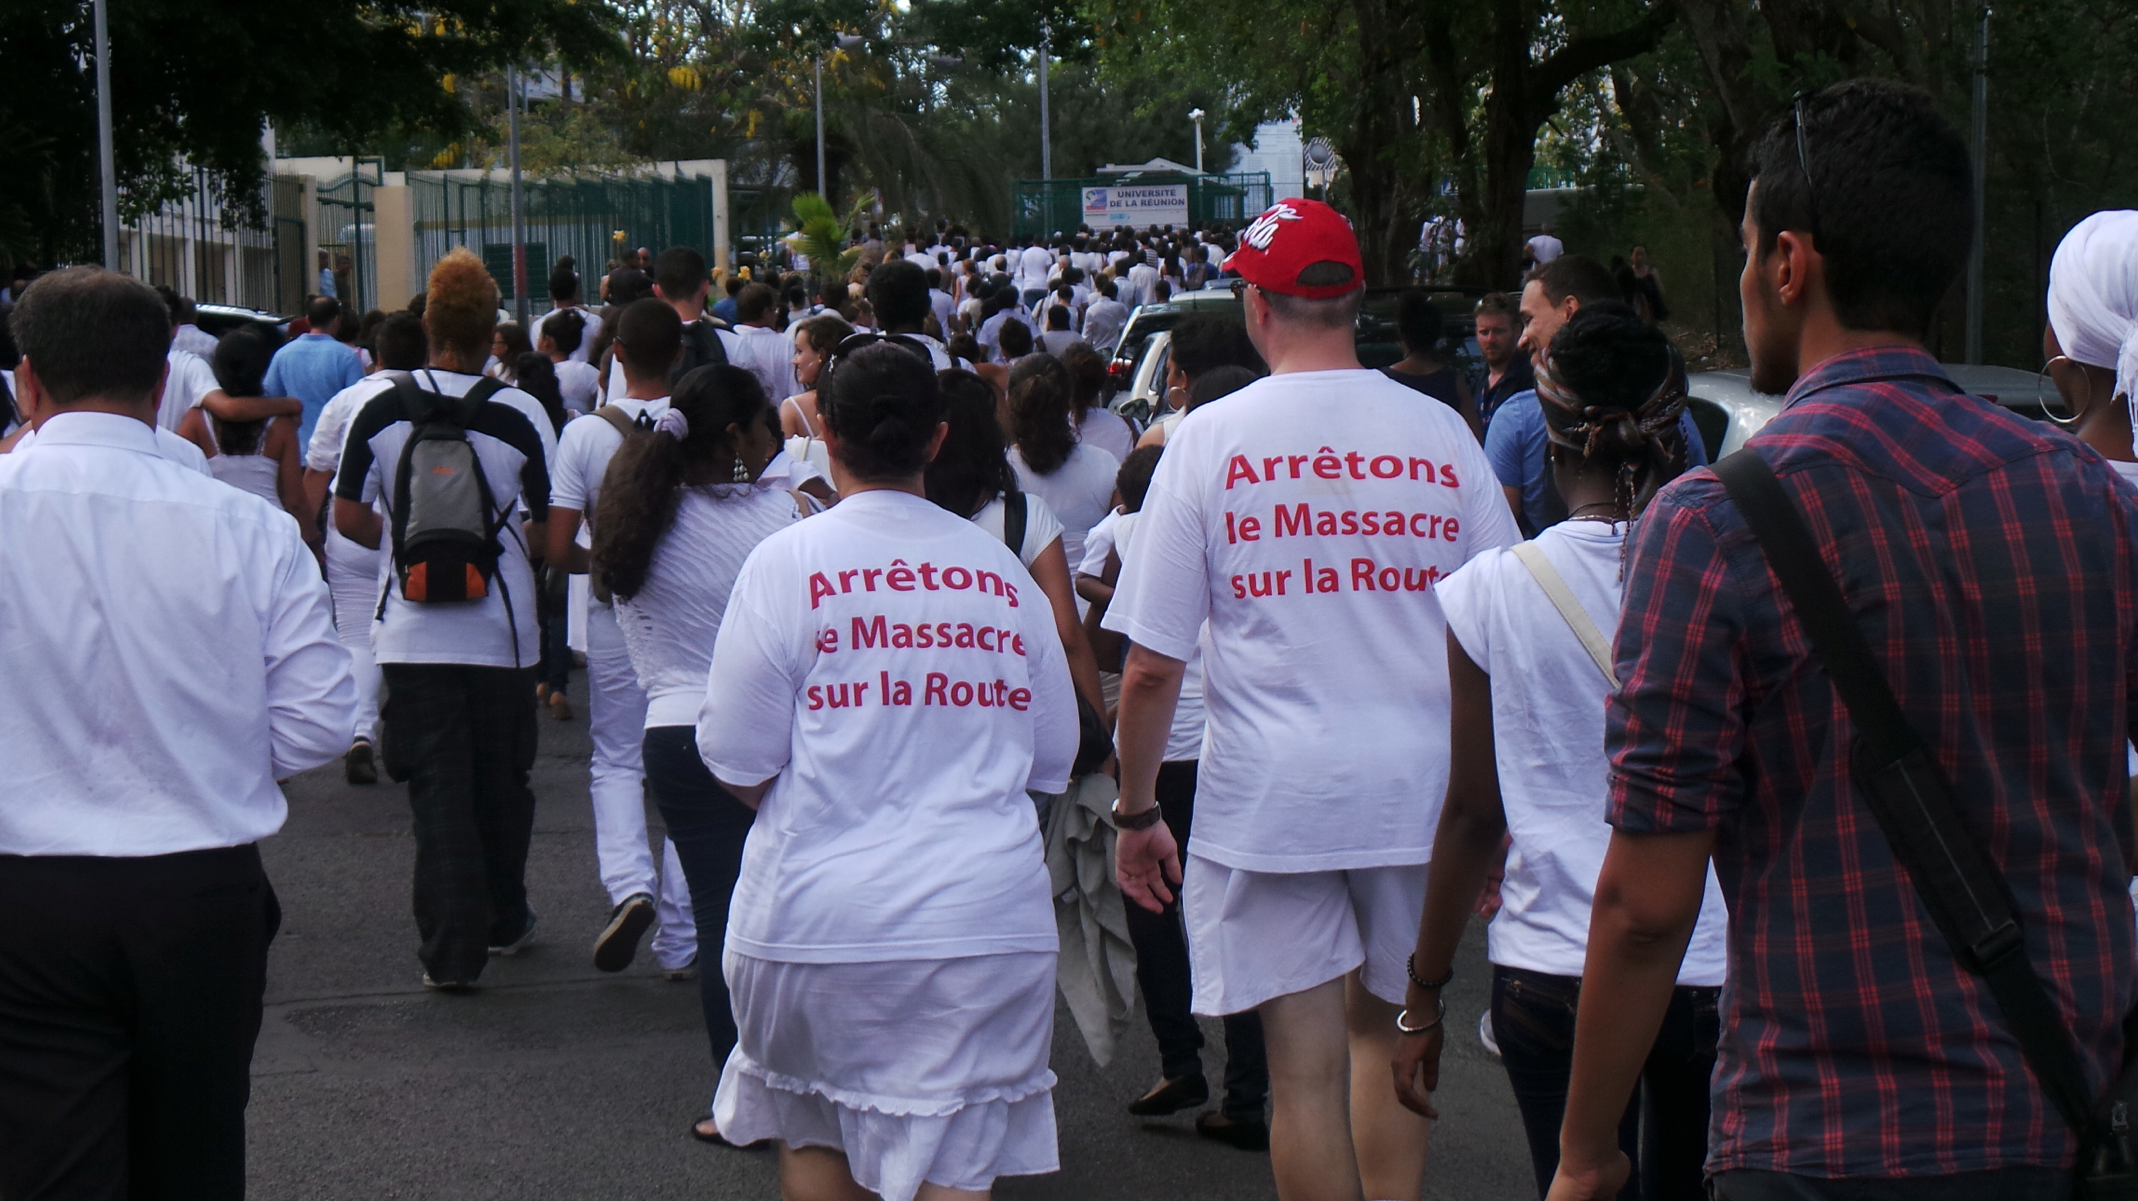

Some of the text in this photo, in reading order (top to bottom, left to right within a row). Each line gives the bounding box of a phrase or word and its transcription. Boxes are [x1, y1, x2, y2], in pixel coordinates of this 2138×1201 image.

[1109, 200, 1122, 208] DE
[1125, 199, 1138, 207] LA
[1140, 198, 1185, 207] RÉUNION
[1117, 189, 1177, 198] UNIVERSITÉ
[1225, 446, 1460, 490] Arrêtons
[1225, 503, 1460, 545] le Massacre
[809, 558, 1020, 610] Arrêtons
[1231, 558, 1452, 599] sur la Rout
[851, 614, 1027, 657] Massacre
[806, 670, 1032, 711] sur la Route
